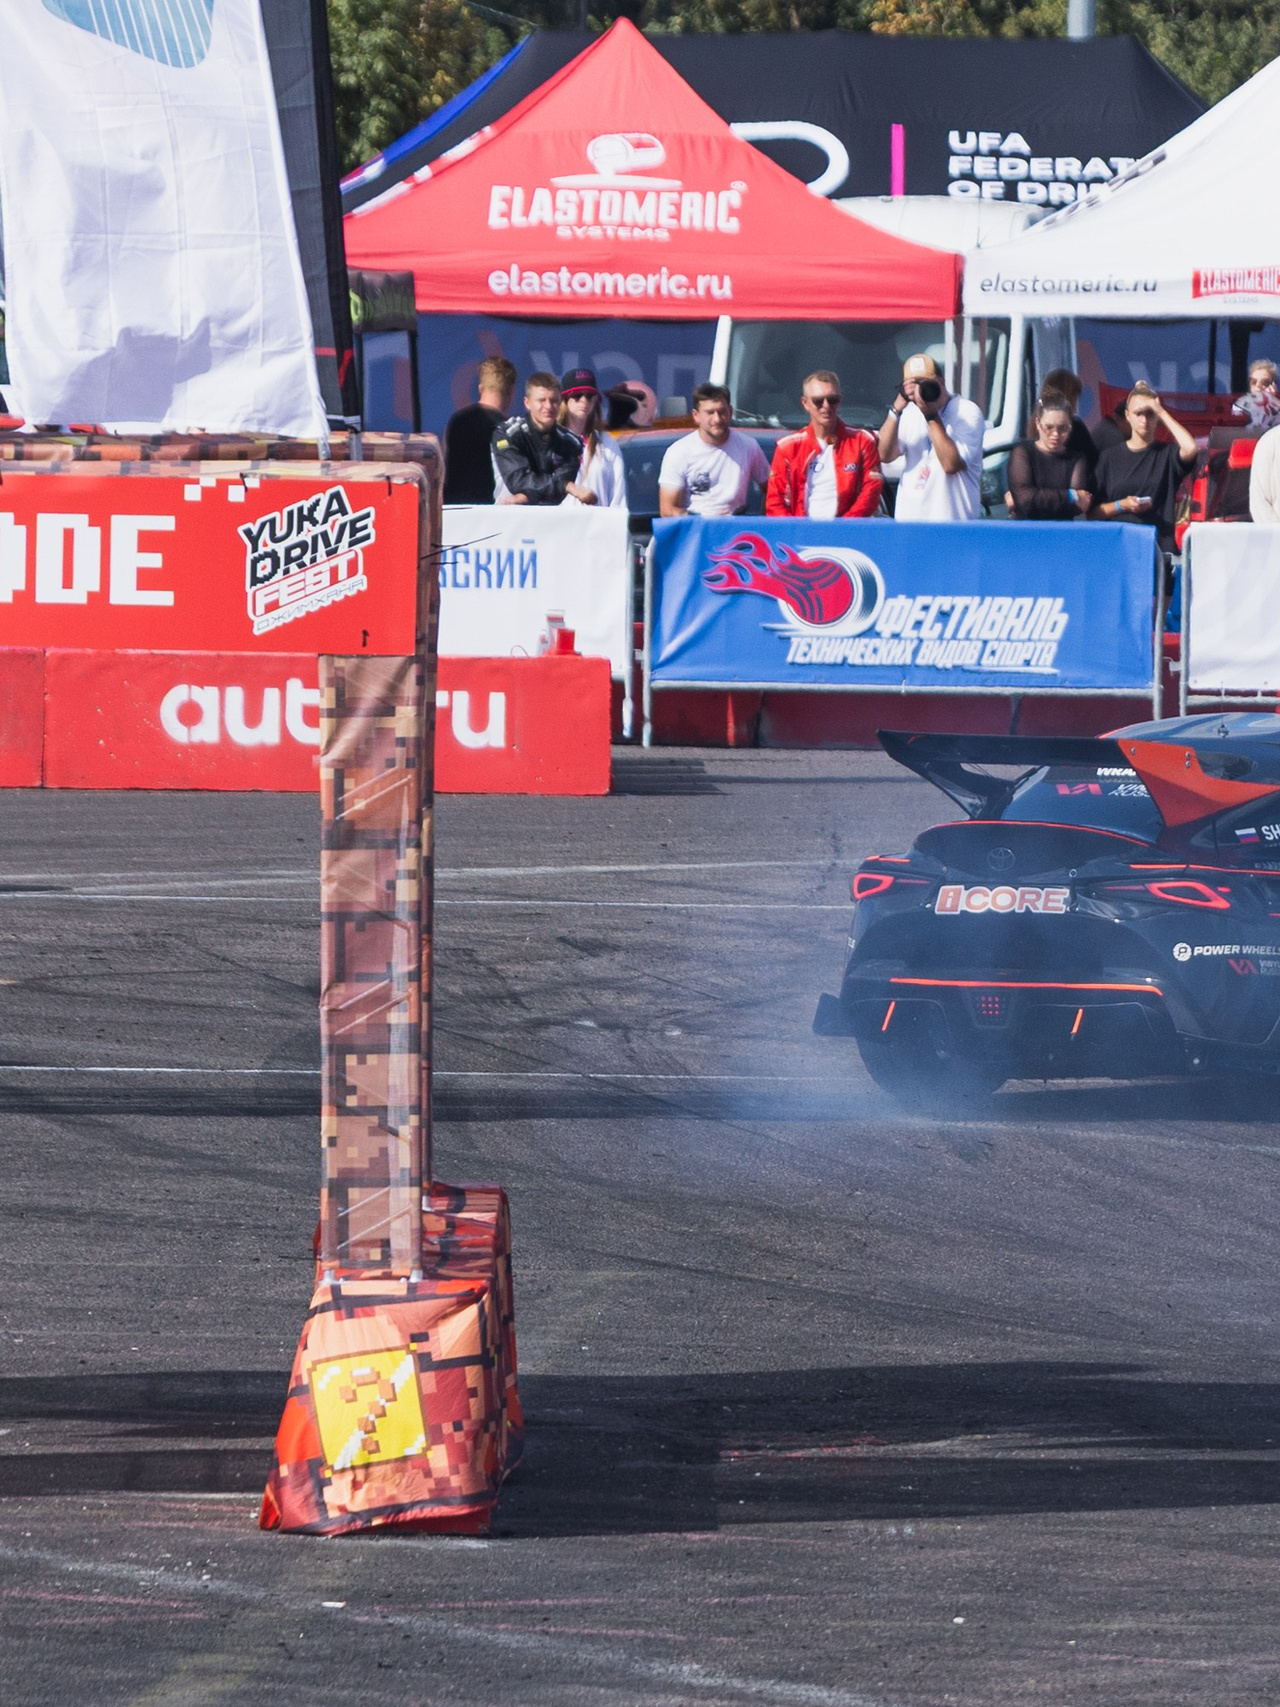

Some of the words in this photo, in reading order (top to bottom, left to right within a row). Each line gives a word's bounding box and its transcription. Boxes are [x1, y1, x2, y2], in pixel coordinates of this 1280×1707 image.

[948, 130, 1032, 155] UFA
[948, 180, 1005, 201] OF
[488, 185, 741, 234] ELASTOMERIC
[556, 225, 670, 241] SYSTEMS
[488, 263, 732, 298] elastomeric.ru
[980, 272, 1158, 293] elastomeric.ru
[242, 489, 349, 554] YUKA
[250, 511, 371, 589] DRIVE
[254, 550, 356, 616] FEST
[874, 594, 1069, 641] ФЕСТИВАЛЬ
[786, 637, 918, 666] ТЕХНИЧЕСКИХ
[915, 640, 982, 669] ВИДОВ
[980, 641, 1058, 667] СПОРТА
[1193, 945, 1241, 956] POWER
